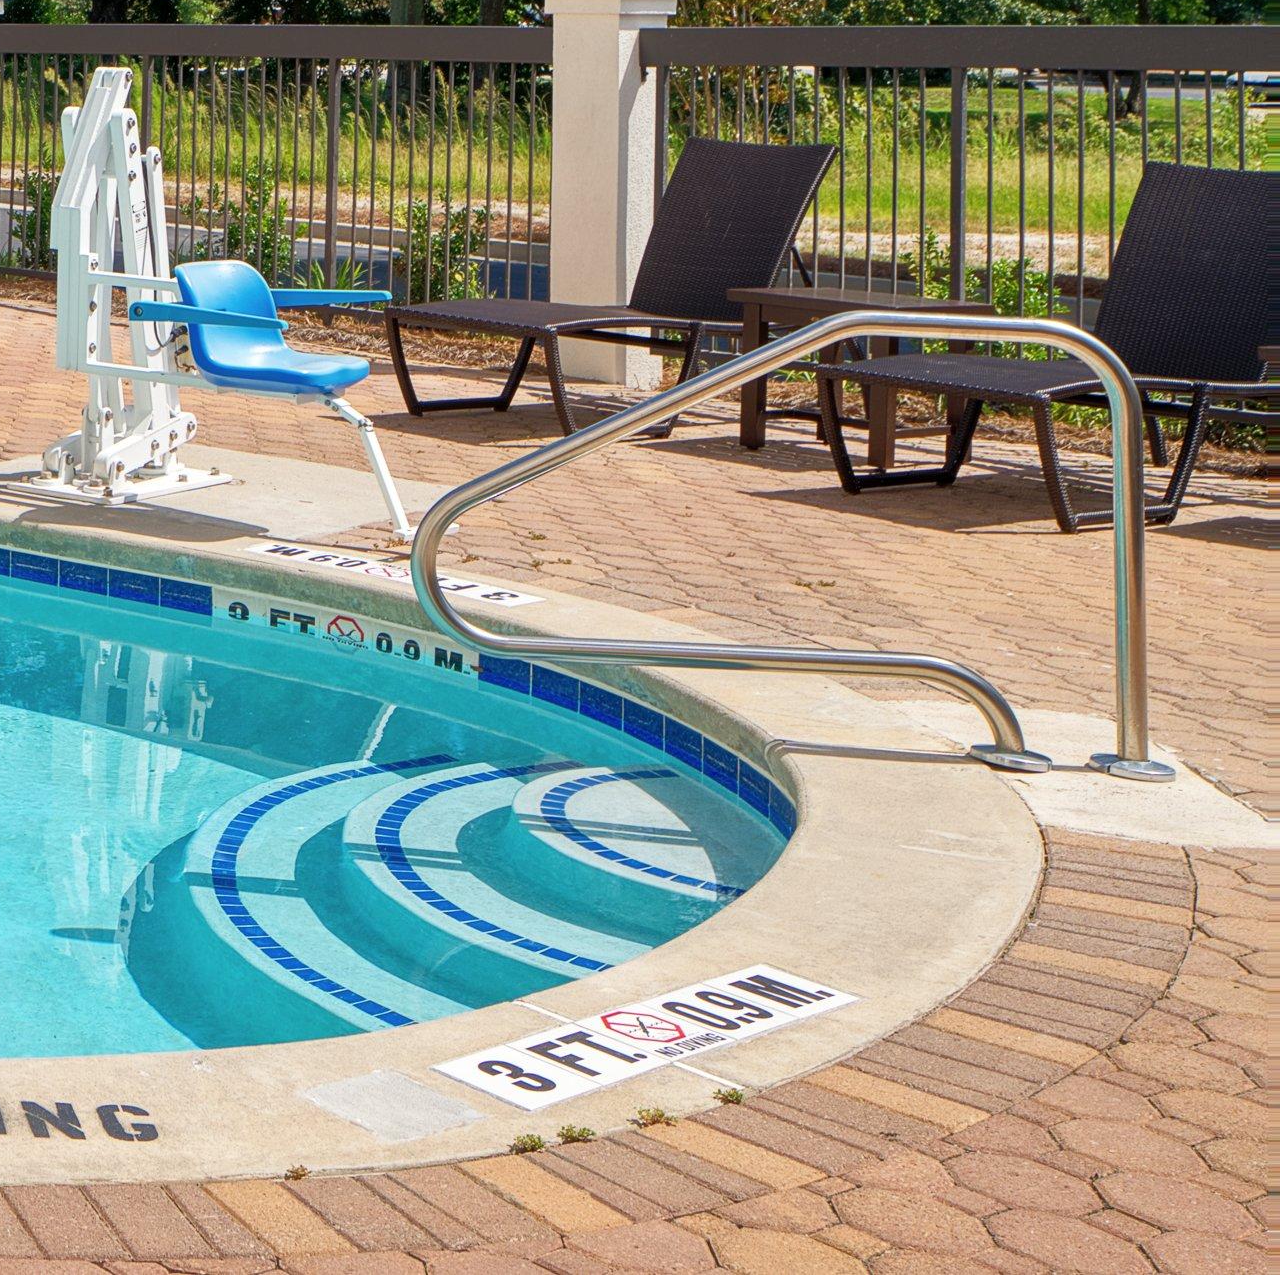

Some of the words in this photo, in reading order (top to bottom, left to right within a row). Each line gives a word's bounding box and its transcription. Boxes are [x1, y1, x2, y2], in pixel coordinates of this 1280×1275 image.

[375, 632, 421, 661] 0.9
[477, 1059, 557, 1093] 3
[526, 1030, 648, 1077] FT.
[661, 991, 774, 1031] 0.9
[729, 974, 836, 1009] M.
[654, 1043, 683, 1058] NO
[683, 1031, 726, 1053] DIVING
